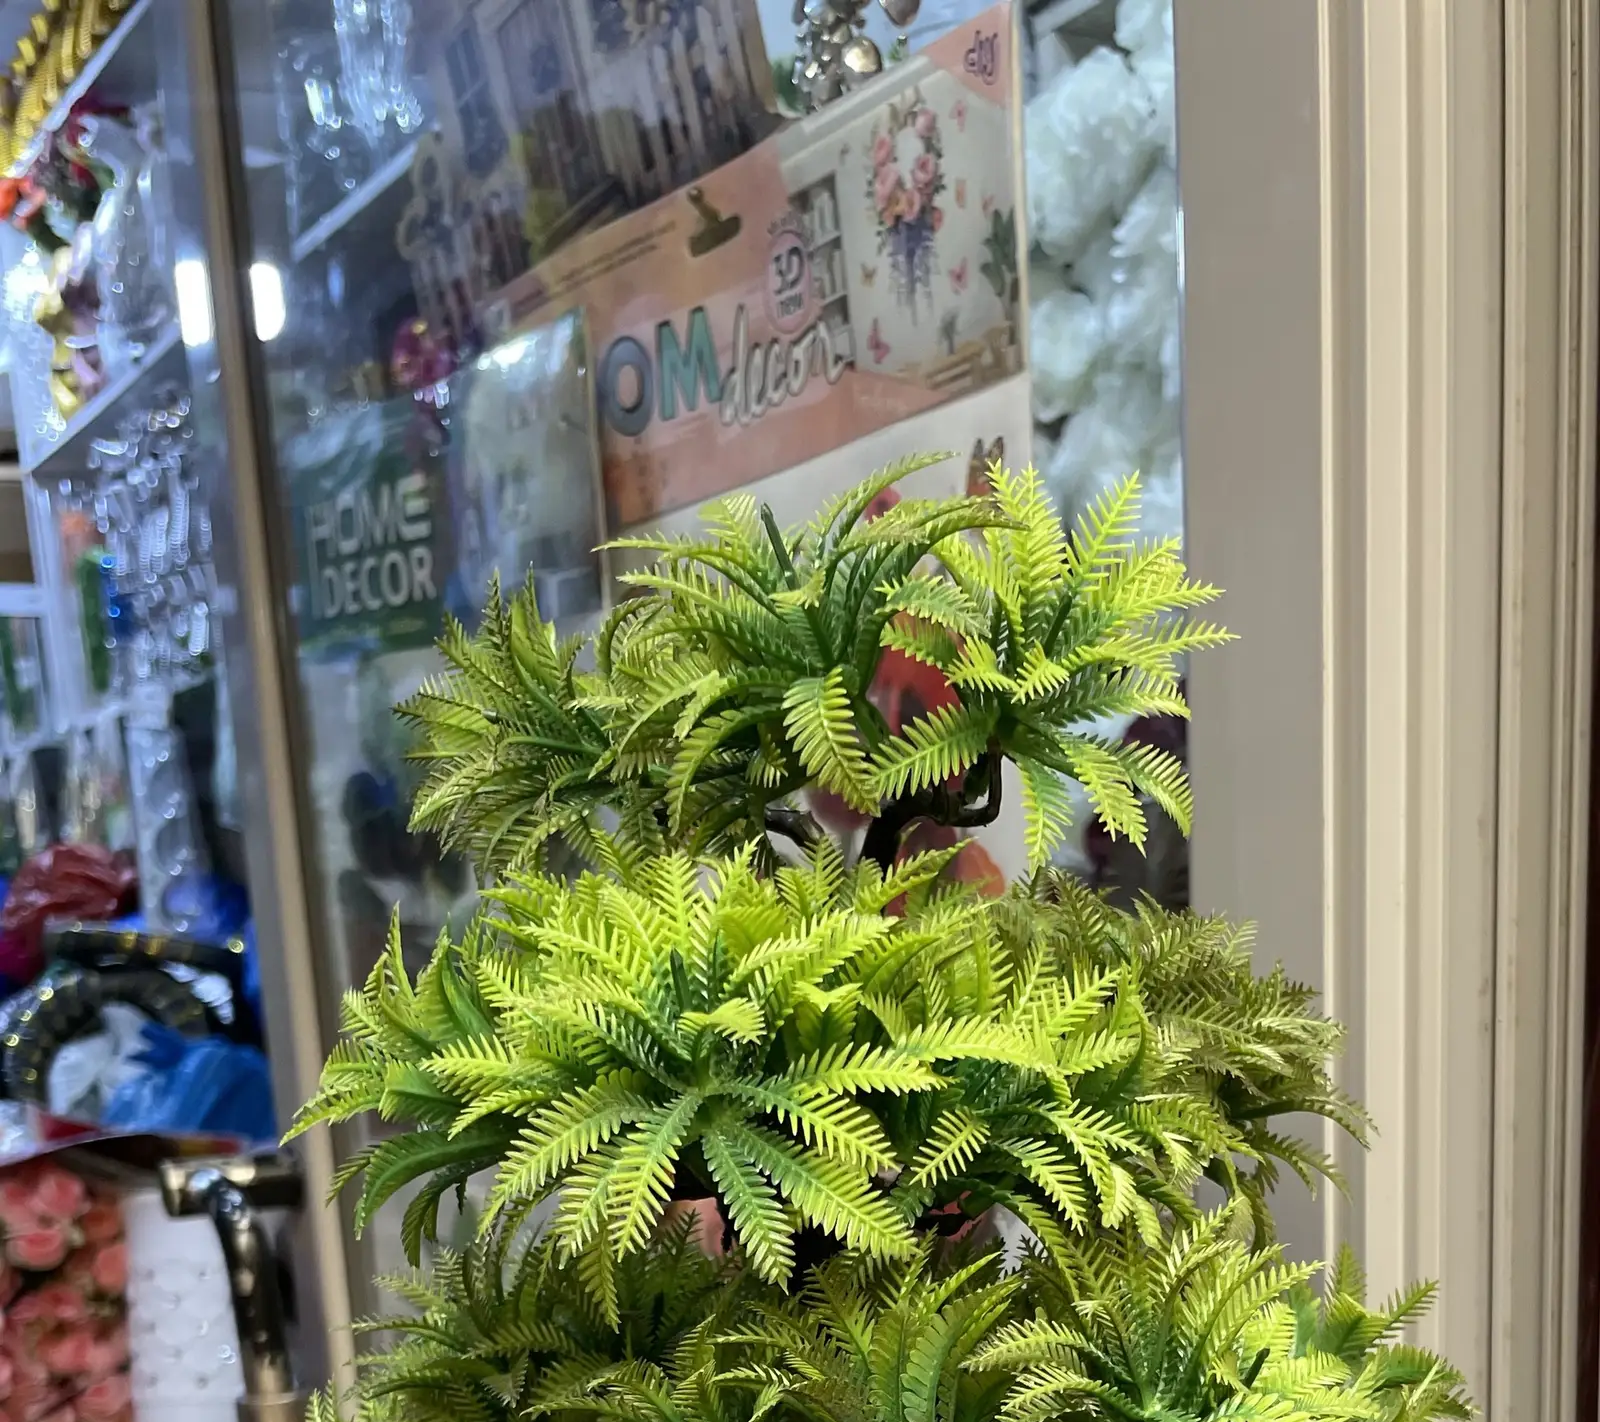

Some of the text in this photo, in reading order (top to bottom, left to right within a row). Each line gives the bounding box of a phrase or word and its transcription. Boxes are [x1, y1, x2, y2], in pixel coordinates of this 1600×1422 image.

[718, 303, 853, 427] decor
[304, 471, 432, 619] HOME
[321, 546, 437, 619] DECOR
